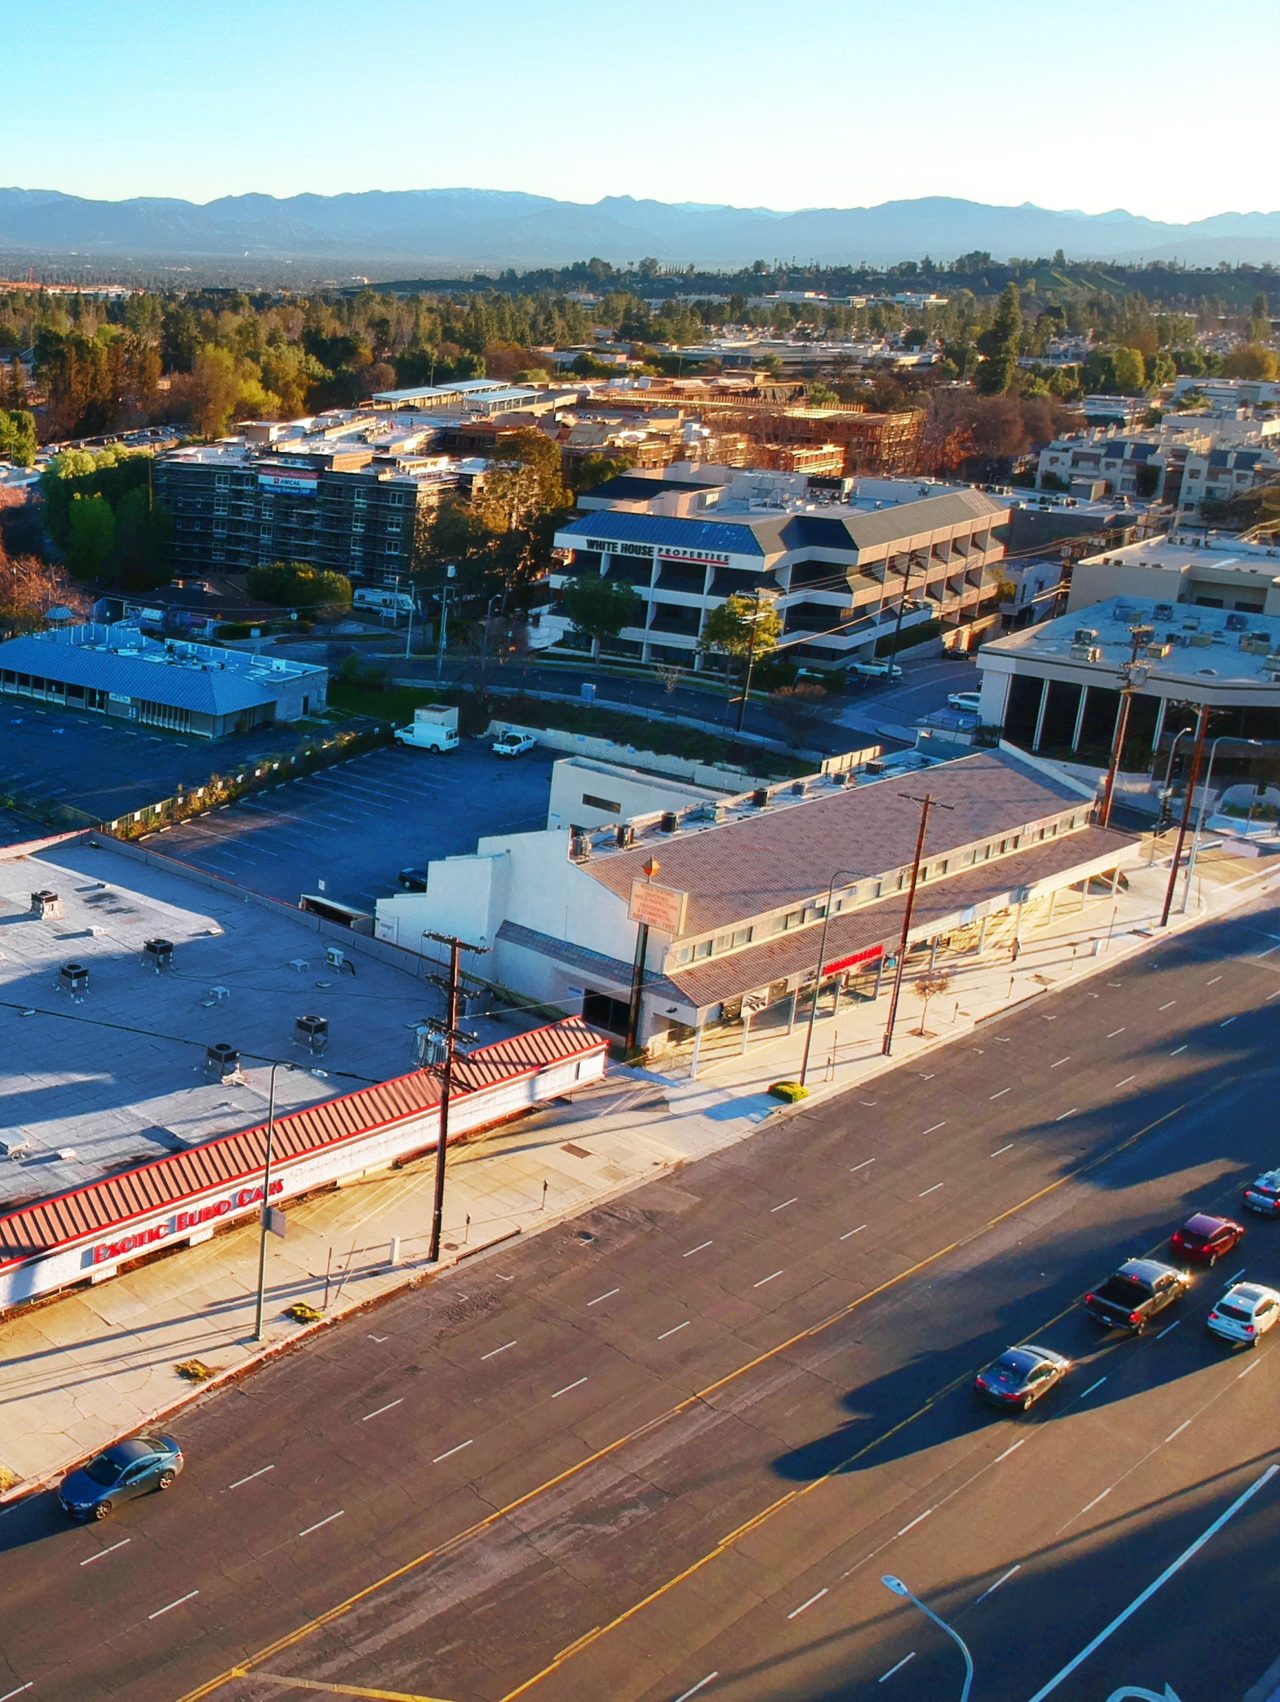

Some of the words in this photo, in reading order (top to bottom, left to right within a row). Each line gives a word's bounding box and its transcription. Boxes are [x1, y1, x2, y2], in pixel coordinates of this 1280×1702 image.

[586, 539, 619, 553] WHITE
[621, 543, 655, 557] HOUSE
[657, 547, 730, 562] PROPERTIES
[92, 1223, 169, 1265] EXOTIC
[176, 1199, 232, 1231] EURO
[237, 1178, 284, 1207] CARS
